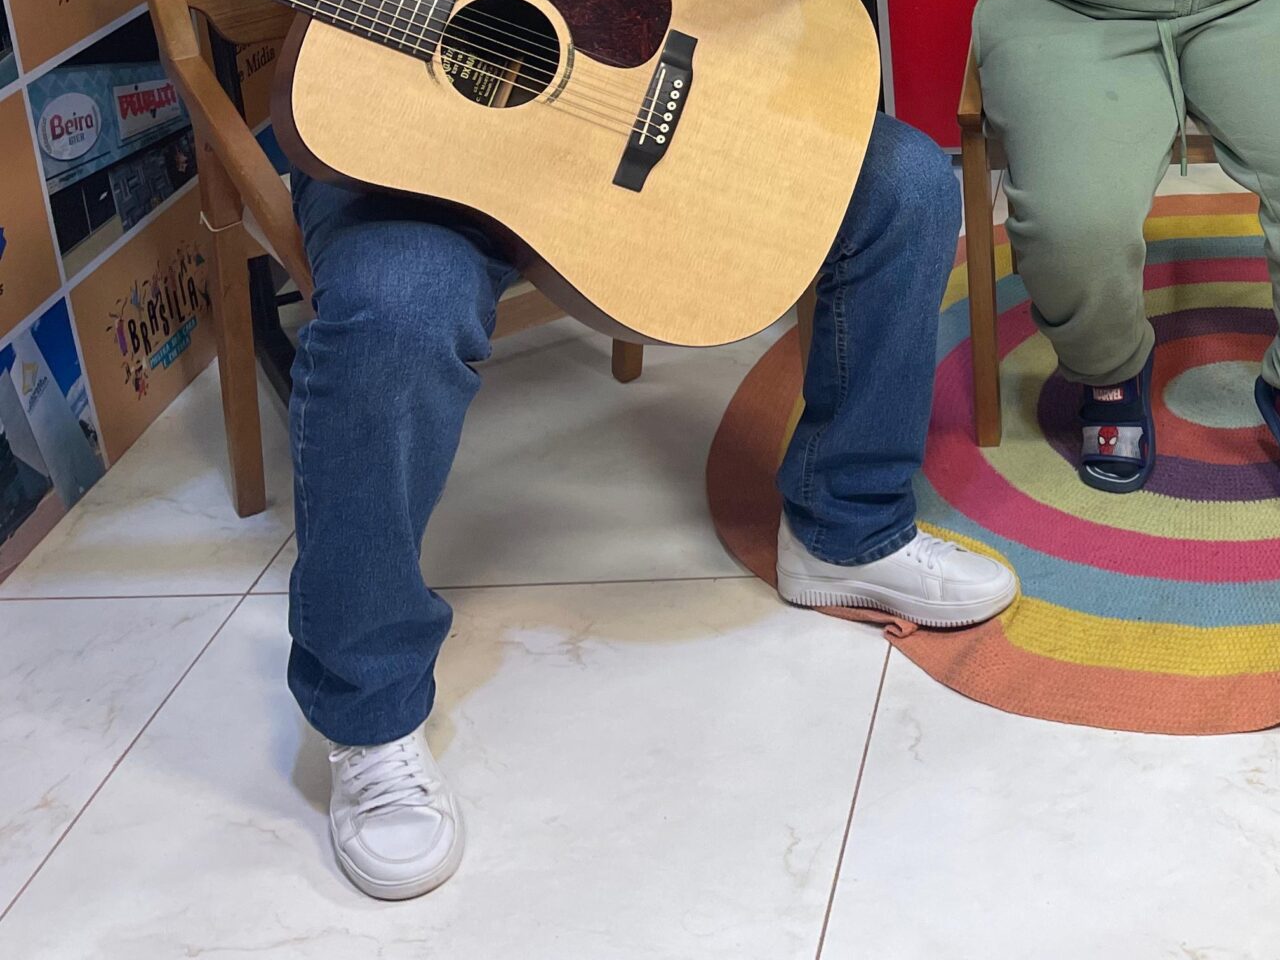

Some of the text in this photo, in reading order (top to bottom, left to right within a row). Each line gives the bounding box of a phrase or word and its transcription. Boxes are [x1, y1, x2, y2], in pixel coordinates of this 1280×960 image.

[50, 111, 94, 141] Beira
[68, 132, 86, 147] BIER
[1092, 388, 1124, 401] MARVEL
